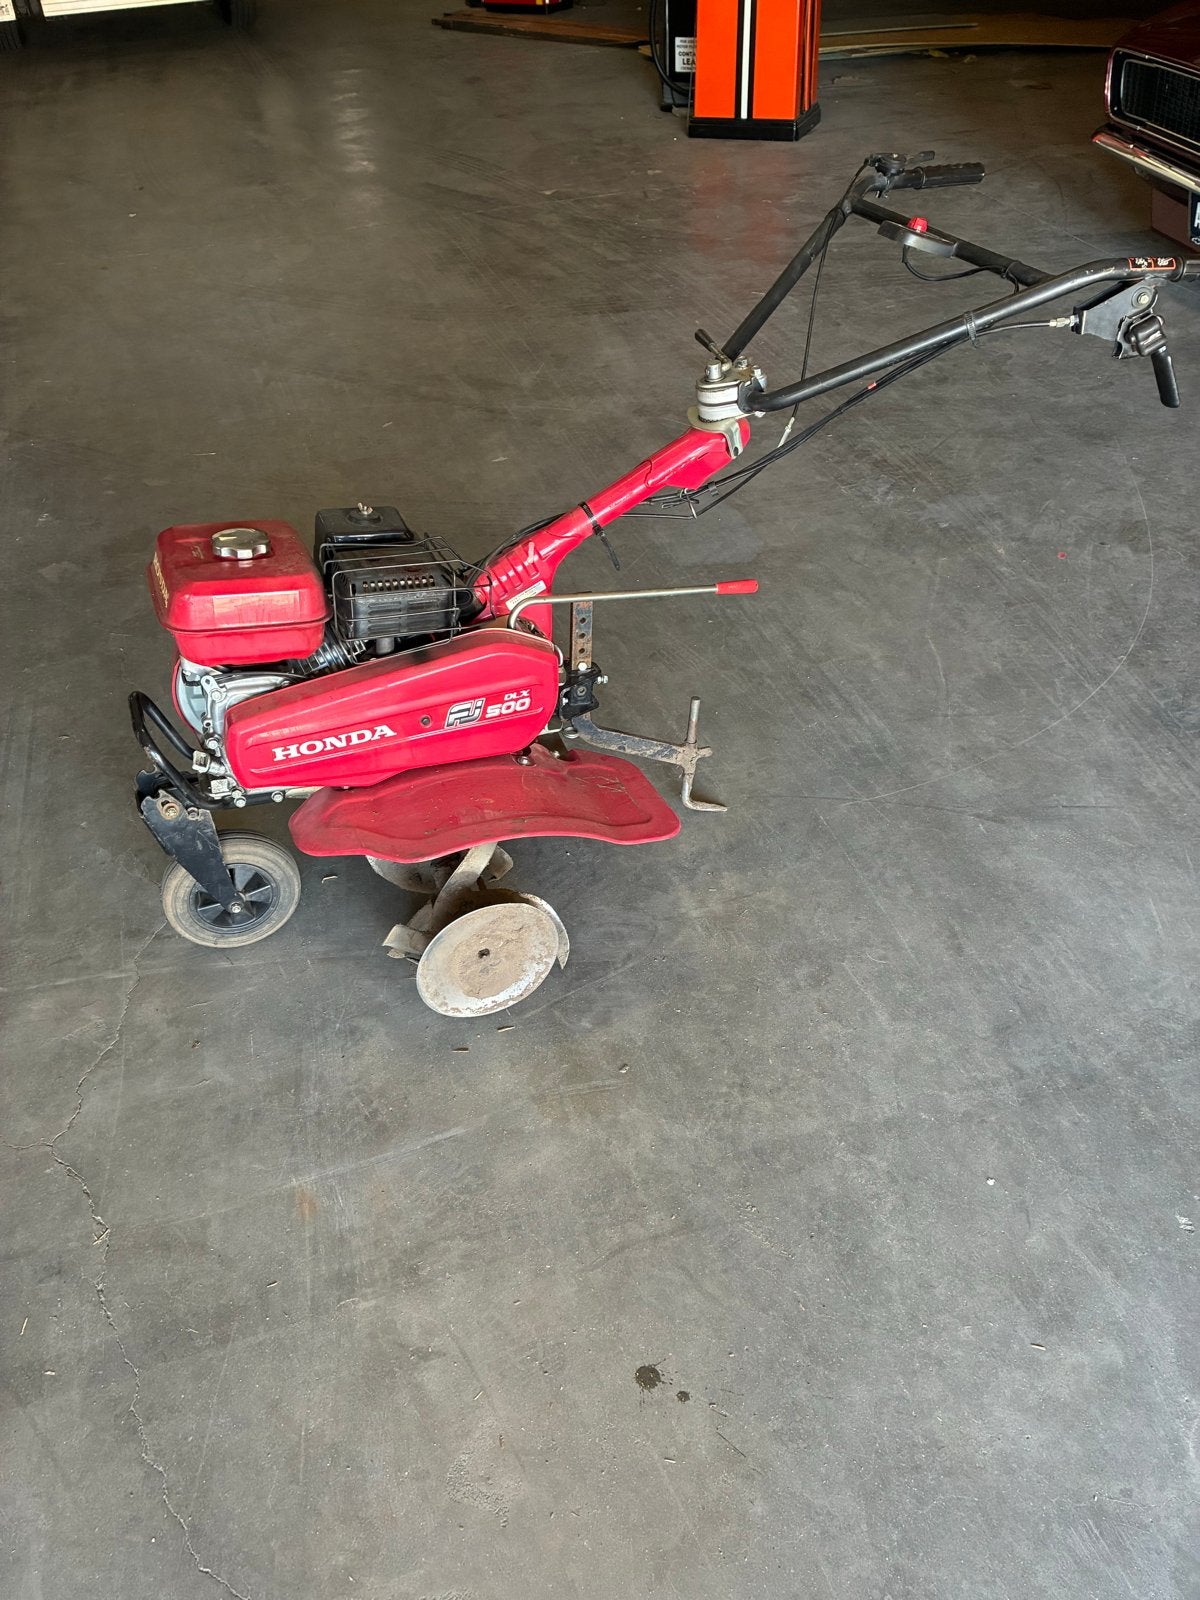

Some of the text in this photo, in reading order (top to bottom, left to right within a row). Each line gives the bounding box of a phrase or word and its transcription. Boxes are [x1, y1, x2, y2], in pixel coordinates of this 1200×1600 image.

[504, 689, 530, 701] DLX
[486, 697, 531, 719] 500
[271, 724, 397, 762] HONDA
